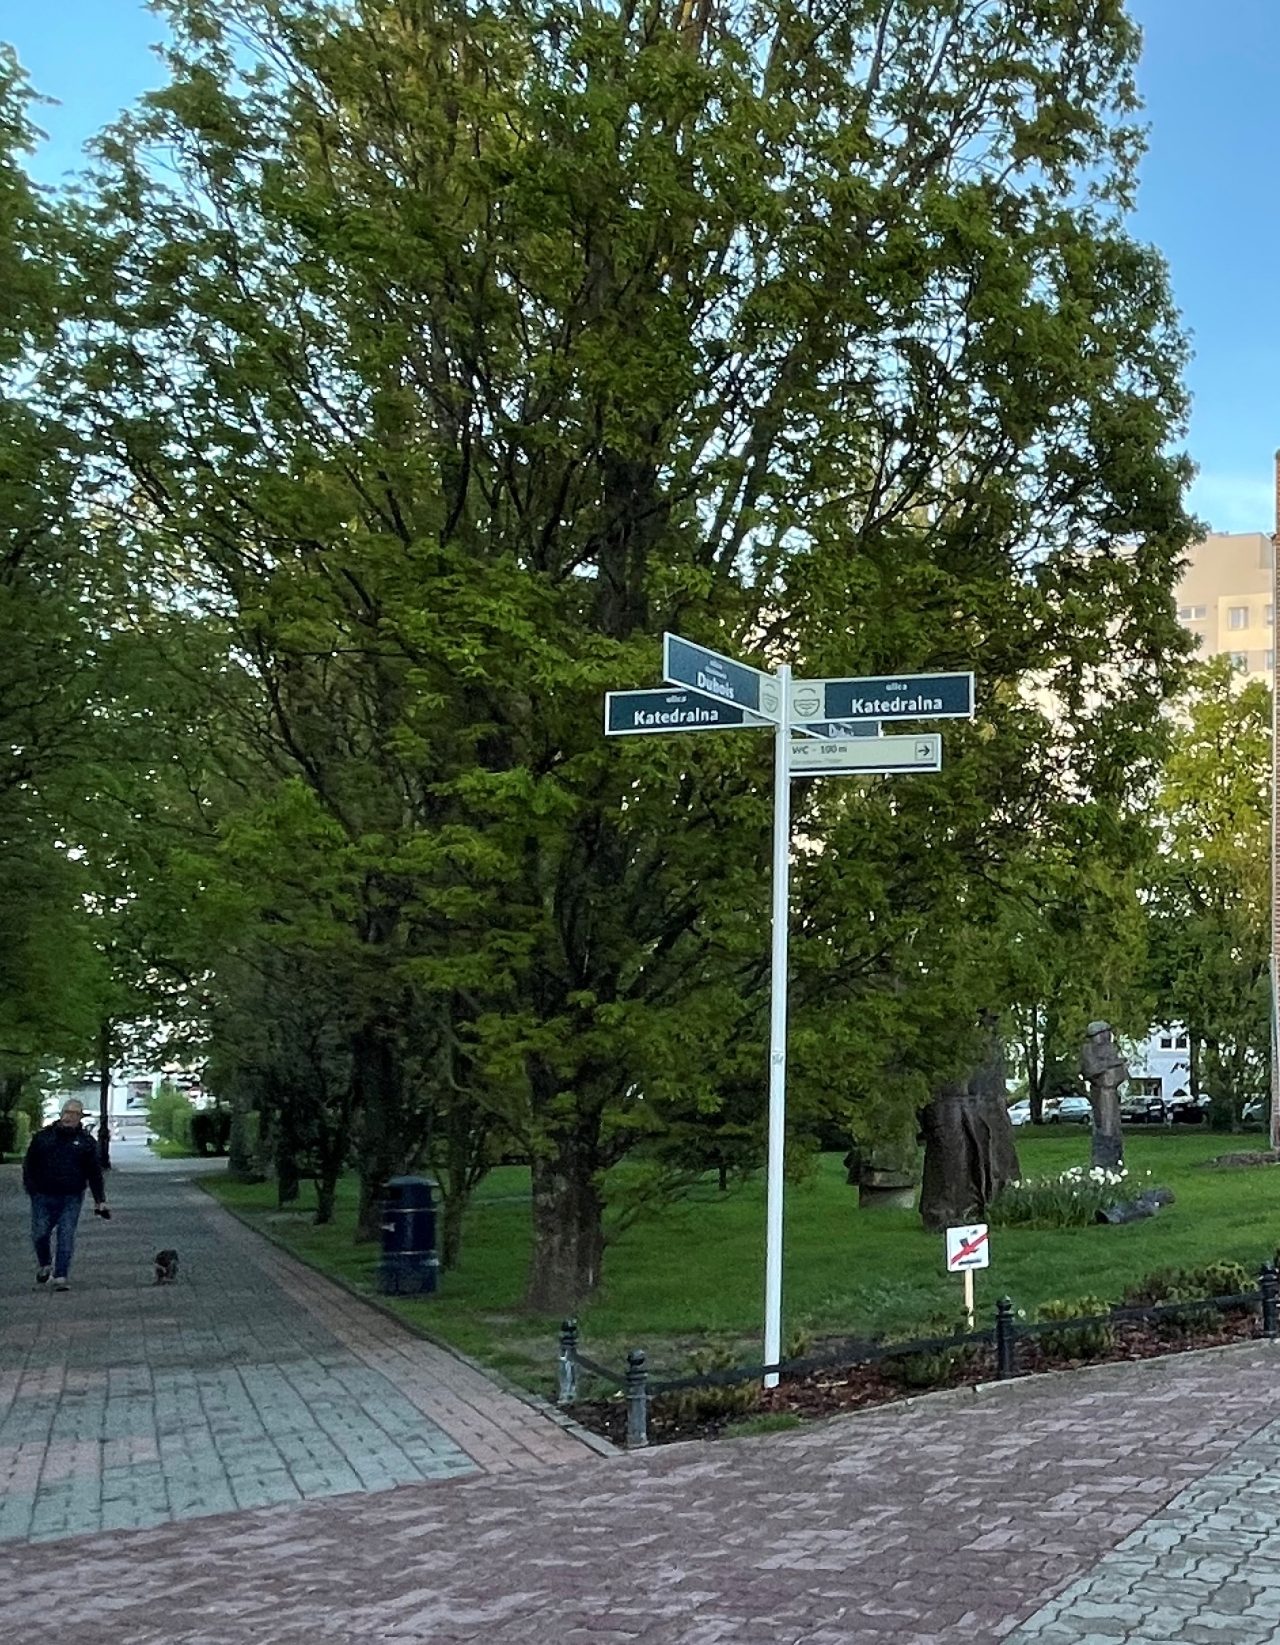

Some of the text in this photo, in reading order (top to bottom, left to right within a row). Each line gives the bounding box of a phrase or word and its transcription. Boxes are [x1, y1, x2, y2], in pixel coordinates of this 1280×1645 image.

[697, 671, 735, 700] Dubois
[851, 695, 943, 714] Katedralna
[634, 707, 719, 726] Katedralna
[792, 745, 809, 755] WC
[820, 744, 837, 755] 100
